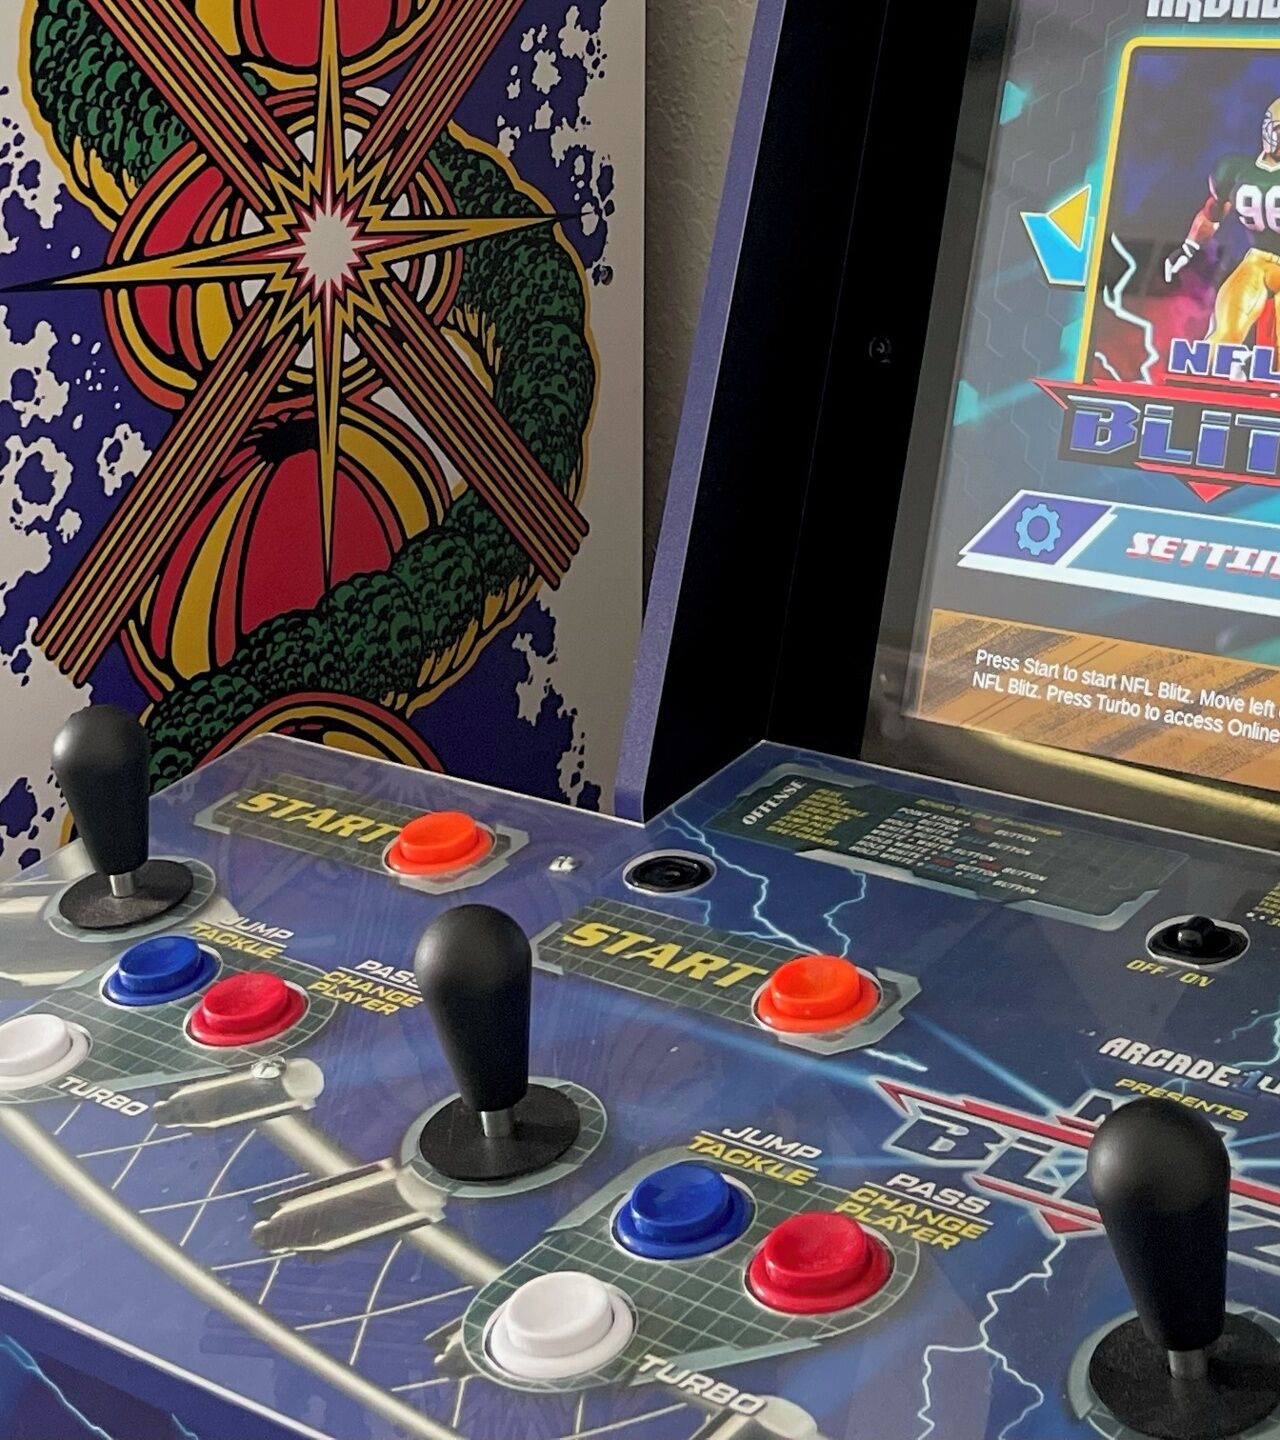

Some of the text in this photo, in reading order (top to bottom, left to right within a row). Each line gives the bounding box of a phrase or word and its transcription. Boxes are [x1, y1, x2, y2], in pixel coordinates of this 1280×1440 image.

[975, 648, 1020, 672] Press
[1023, 656, 1060, 679] Start
[1063, 662, 1078, 681] to
[1081, 666, 1117, 690] start
[1120, 674, 1154, 697] NFL
[1157, 680, 1195, 705] Blitz.
[1200, 689, 1246, 713] Move
[1248, 696, 1276, 719] left
[973, 670, 1005, 694] NFL
[1006, 677, 1042, 700] Blitz.
[1046, 684, 1092, 709] Press
[1096, 693, 1141, 718] Turbo
[1144, 701, 1160, 721] to
[1163, 709, 1224, 734] access
[1227, 717, 1280, 745] Online
[234, 791, 404, 845] START
[742, 779, 808, 825] OFFENSE
[190, 921, 284, 959] TACKLE
[214, 915, 294, 941] JUMP
[561, 920, 770, 989] START
[1125, 957, 1215, 987] OFF ON
[309, 981, 400, 1016] PLAYER
[323, 971, 424, 1008] CHANGE
[56, 1075, 149, 1118] TURBO
[1115, 1077, 1249, 1120] PRESENTS
[690, 1135, 820, 1187] TACKLE
[721, 1125, 823, 1161] JUMP
[849, 1185, 990, 1241] CHANGE
[885, 1172, 994, 1215] PASS
[835, 1201, 961, 1250] PLAYER
[635, 1353, 766, 1417] TURBO
